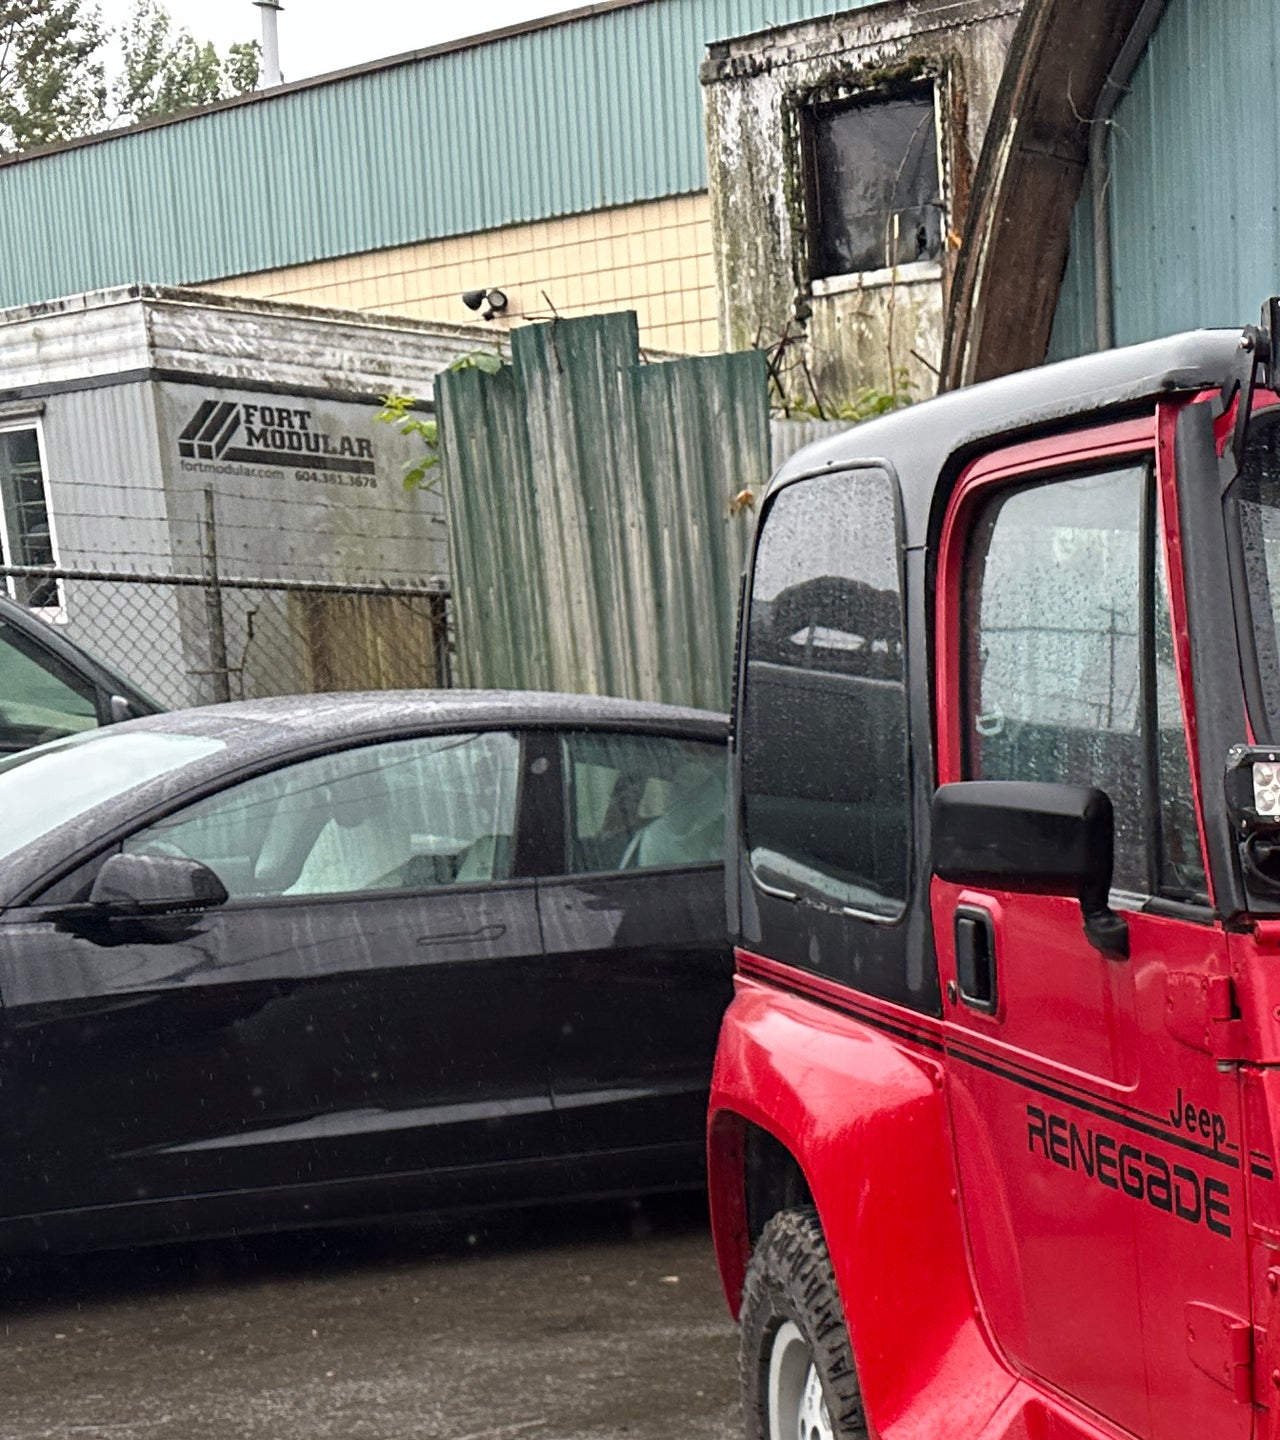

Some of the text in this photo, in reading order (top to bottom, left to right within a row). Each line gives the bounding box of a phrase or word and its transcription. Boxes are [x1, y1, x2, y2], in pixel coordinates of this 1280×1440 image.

[241, 403, 312, 431] FORT
[244, 426, 375, 459] MODULAR
[1170, 1088, 1227, 1150] Jeep
